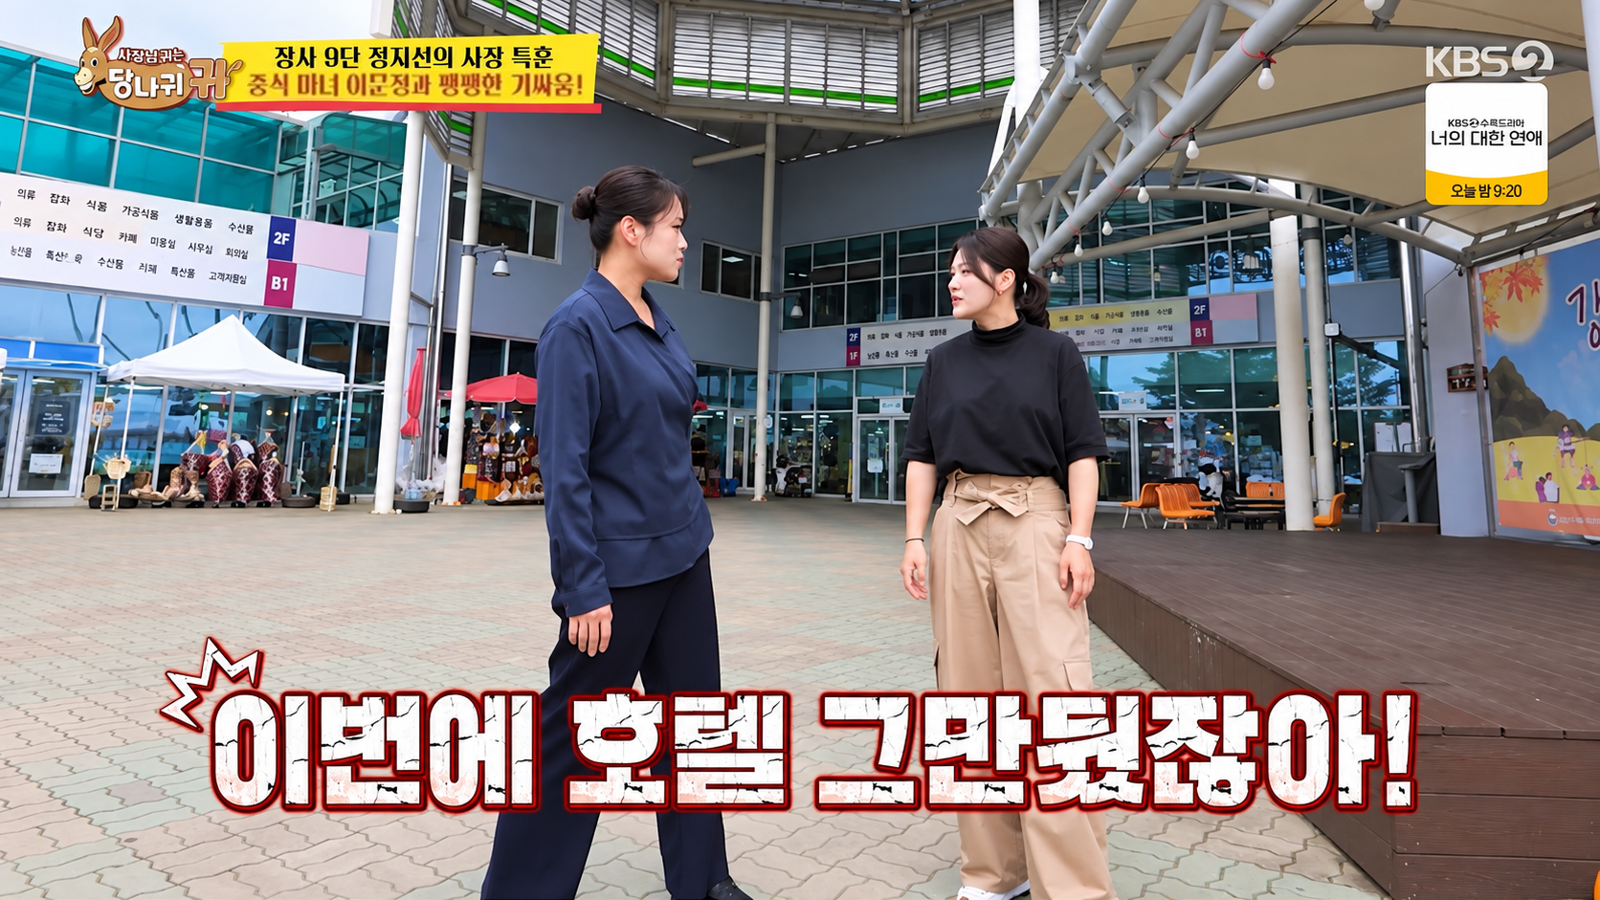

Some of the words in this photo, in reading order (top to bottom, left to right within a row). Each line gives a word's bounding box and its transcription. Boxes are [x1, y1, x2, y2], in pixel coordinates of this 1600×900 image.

[273, 231, 291, 246] 2F
[270, 275, 289, 292] B1
[1193, 305, 1206, 315] 2F
[849, 333, 859, 341] 2F
[849, 351, 858, 360] 1F
